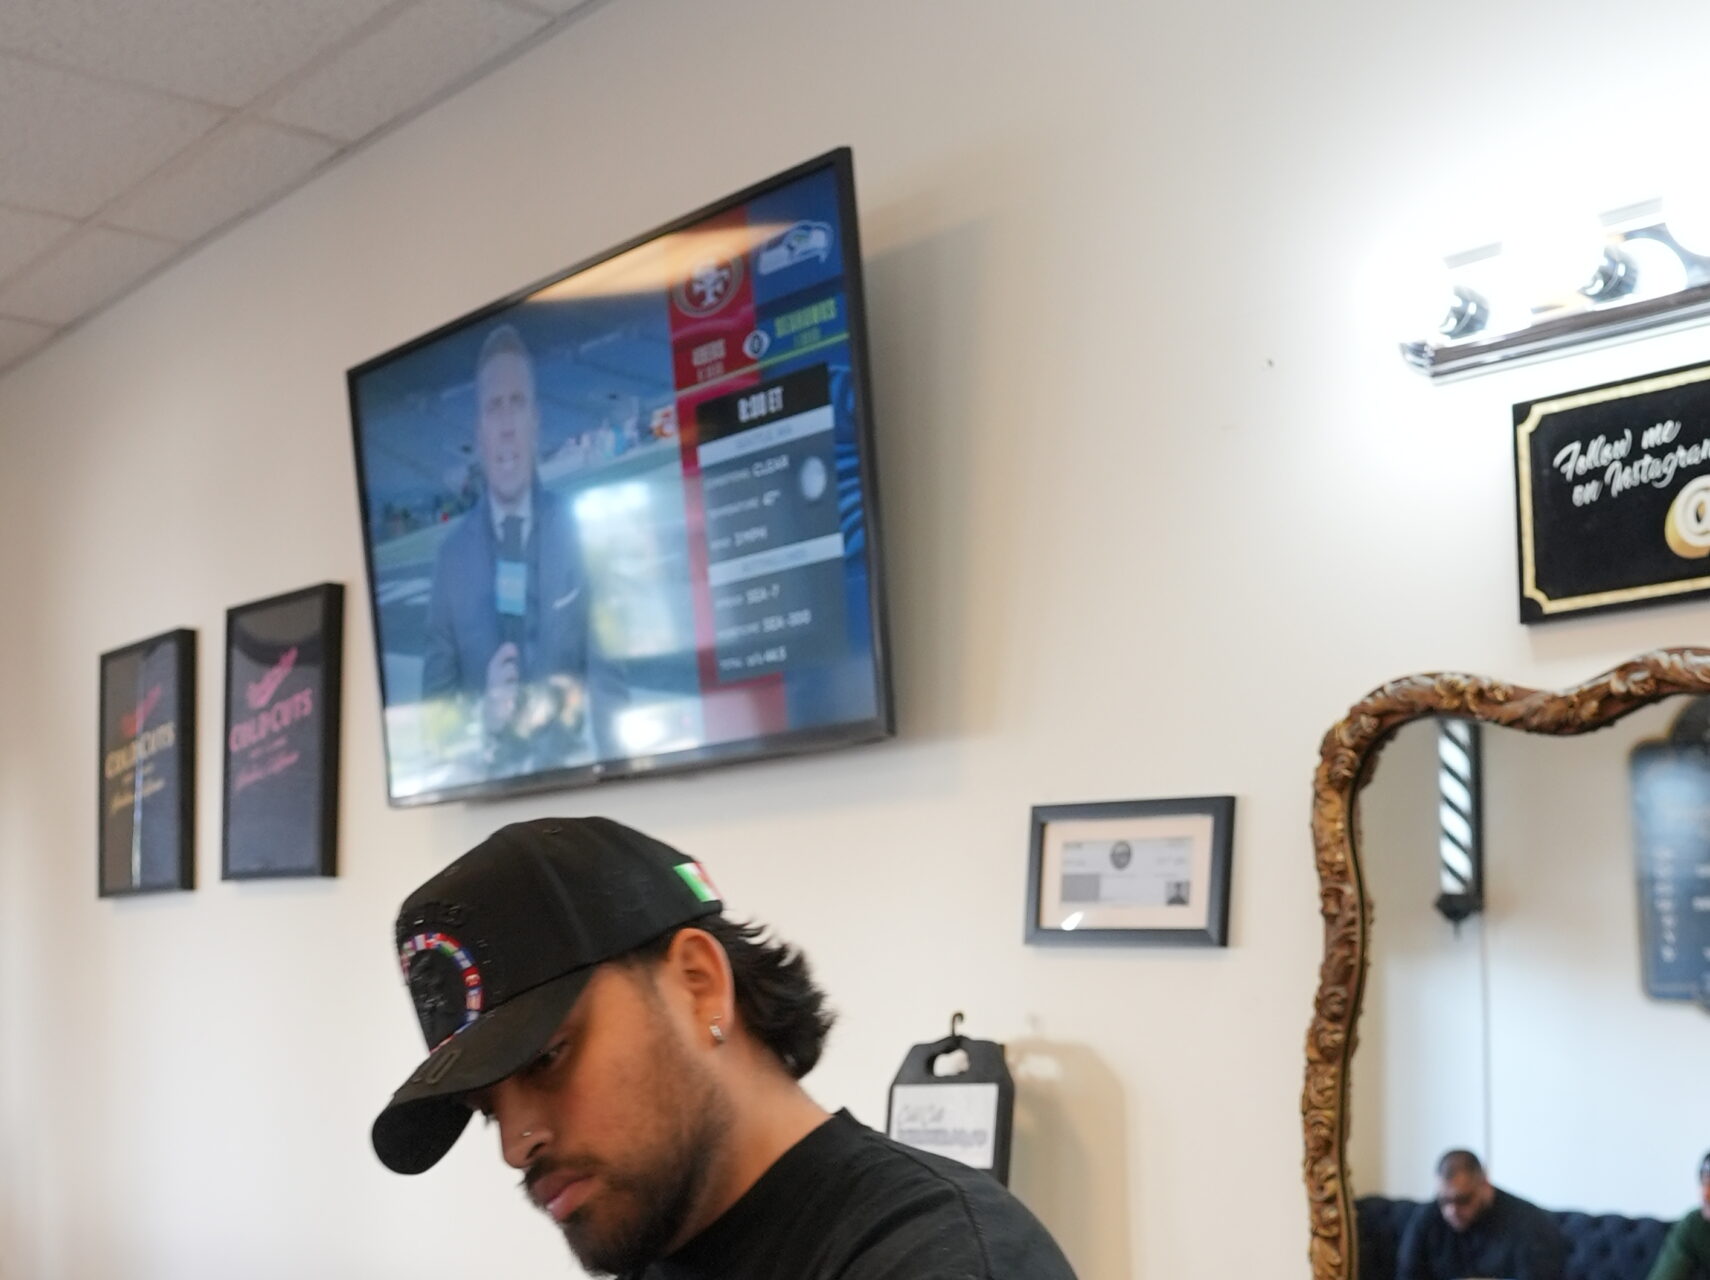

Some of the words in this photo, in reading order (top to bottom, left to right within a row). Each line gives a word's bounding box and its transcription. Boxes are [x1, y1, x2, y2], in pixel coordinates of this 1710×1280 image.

[1553, 428, 1632, 482] Follow
[1641, 419, 1682, 450] me
[1572, 480, 1603, 507] on
